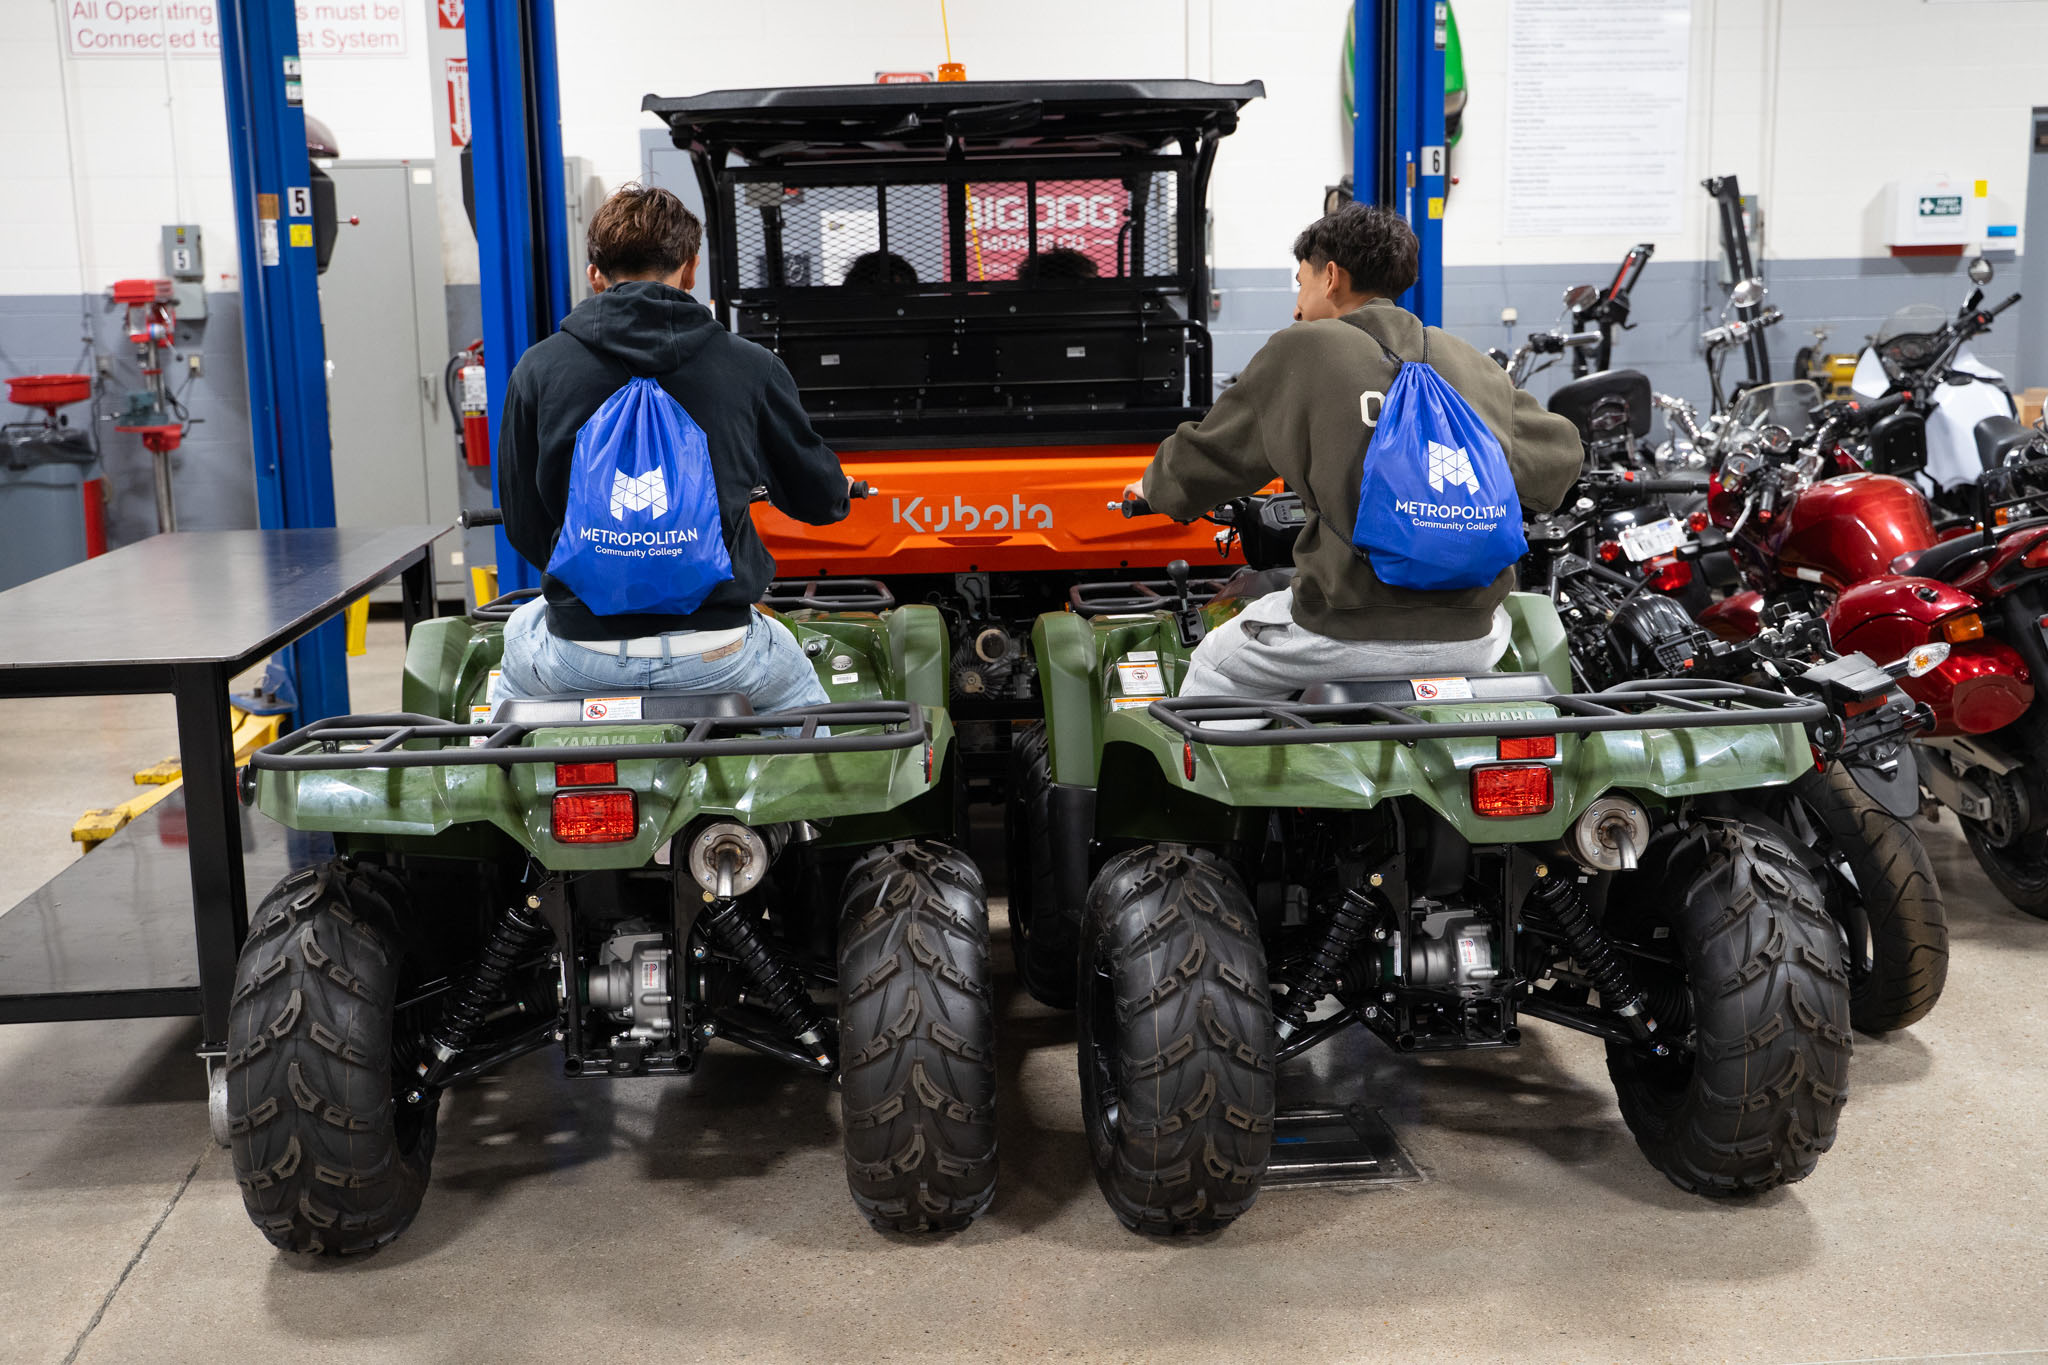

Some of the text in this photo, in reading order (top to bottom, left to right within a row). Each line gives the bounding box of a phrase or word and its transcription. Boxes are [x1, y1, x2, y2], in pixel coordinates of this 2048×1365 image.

[73, 0, 98, 19] All
[316, 3, 366, 20] must
[374, 3, 400, 20] be
[78, 28, 196, 48] Conneced
[322, 29, 399, 52] System
[1433, 149, 1440, 174] 6
[294, 189, 305, 214] 5
[178, 251, 186, 268] 5
[892, 494, 1053, 533] Kubota
[1395, 499, 1506, 519] METROPOLITAN
[1412, 518, 1497, 532] Community College
[580, 526, 698, 546] METROPOLITAN
[595, 545, 682, 558] Community College
[1457, 711, 1536, 722] YAMAHA
[554, 735, 637, 747] YAMAHA
